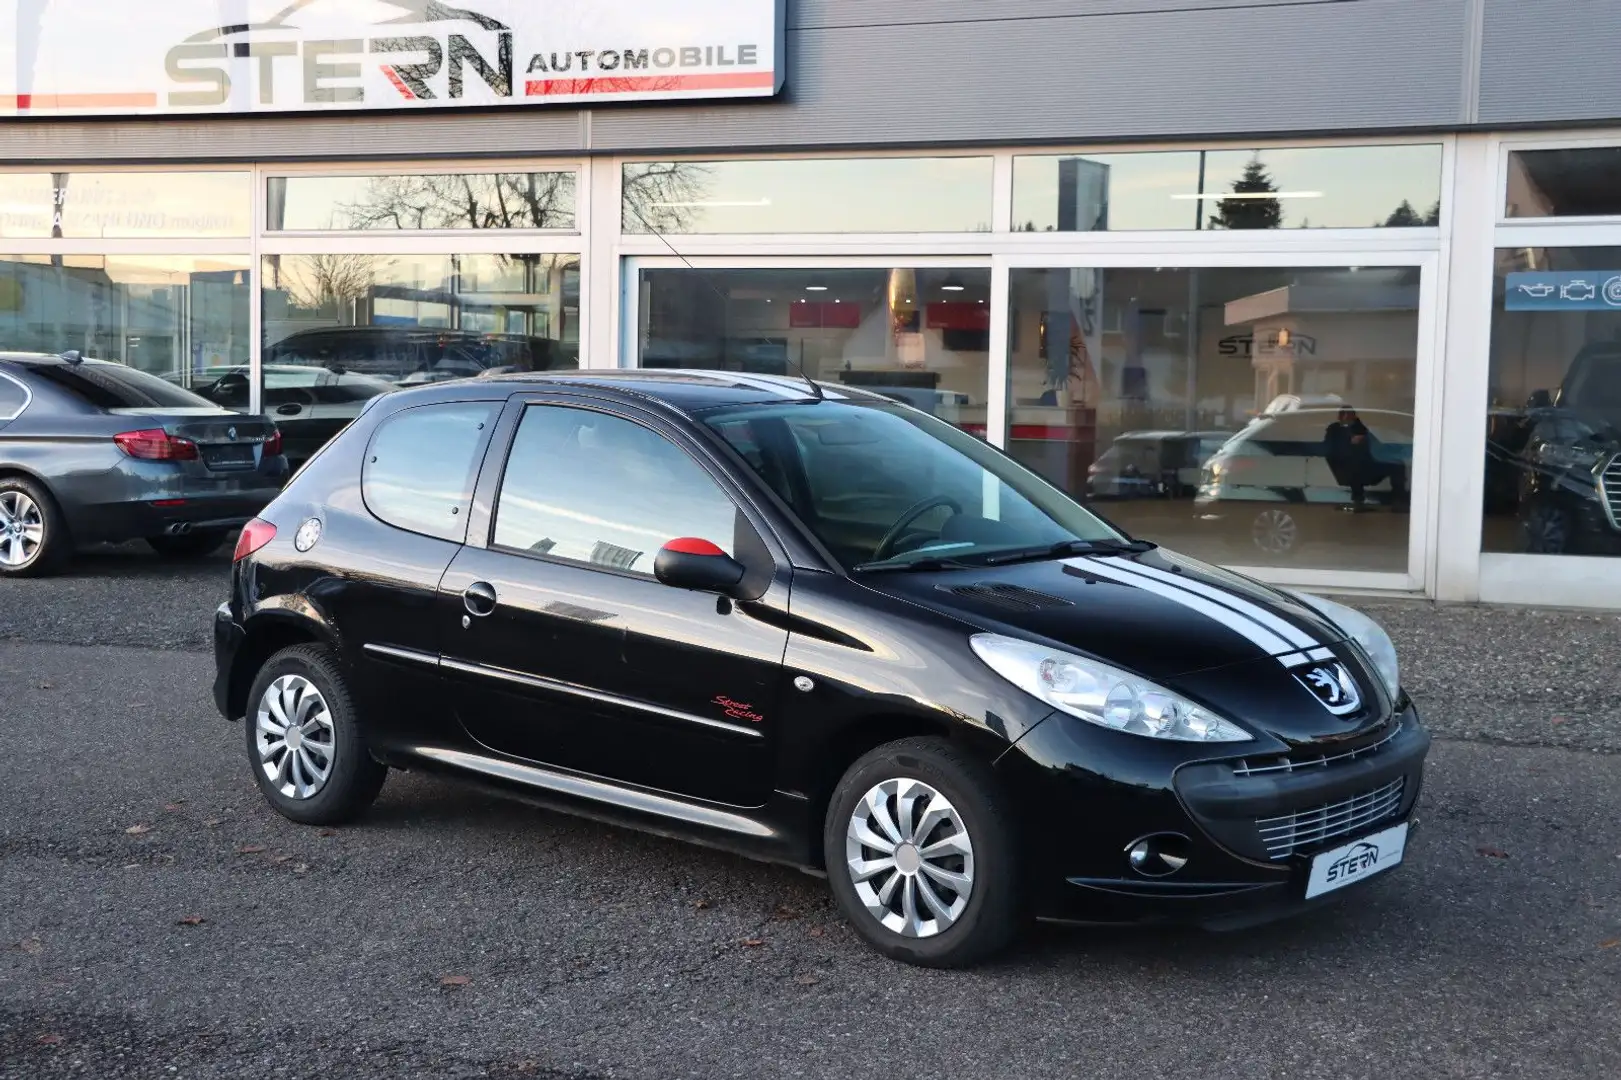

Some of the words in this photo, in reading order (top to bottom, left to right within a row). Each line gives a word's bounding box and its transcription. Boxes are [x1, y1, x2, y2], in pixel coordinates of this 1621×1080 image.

[164, 32, 513, 107] STERN
[526, 44, 757, 73] AUTOMOBILE
[711, 696, 752, 709] Street
[1326, 851, 1379, 882] STERN
